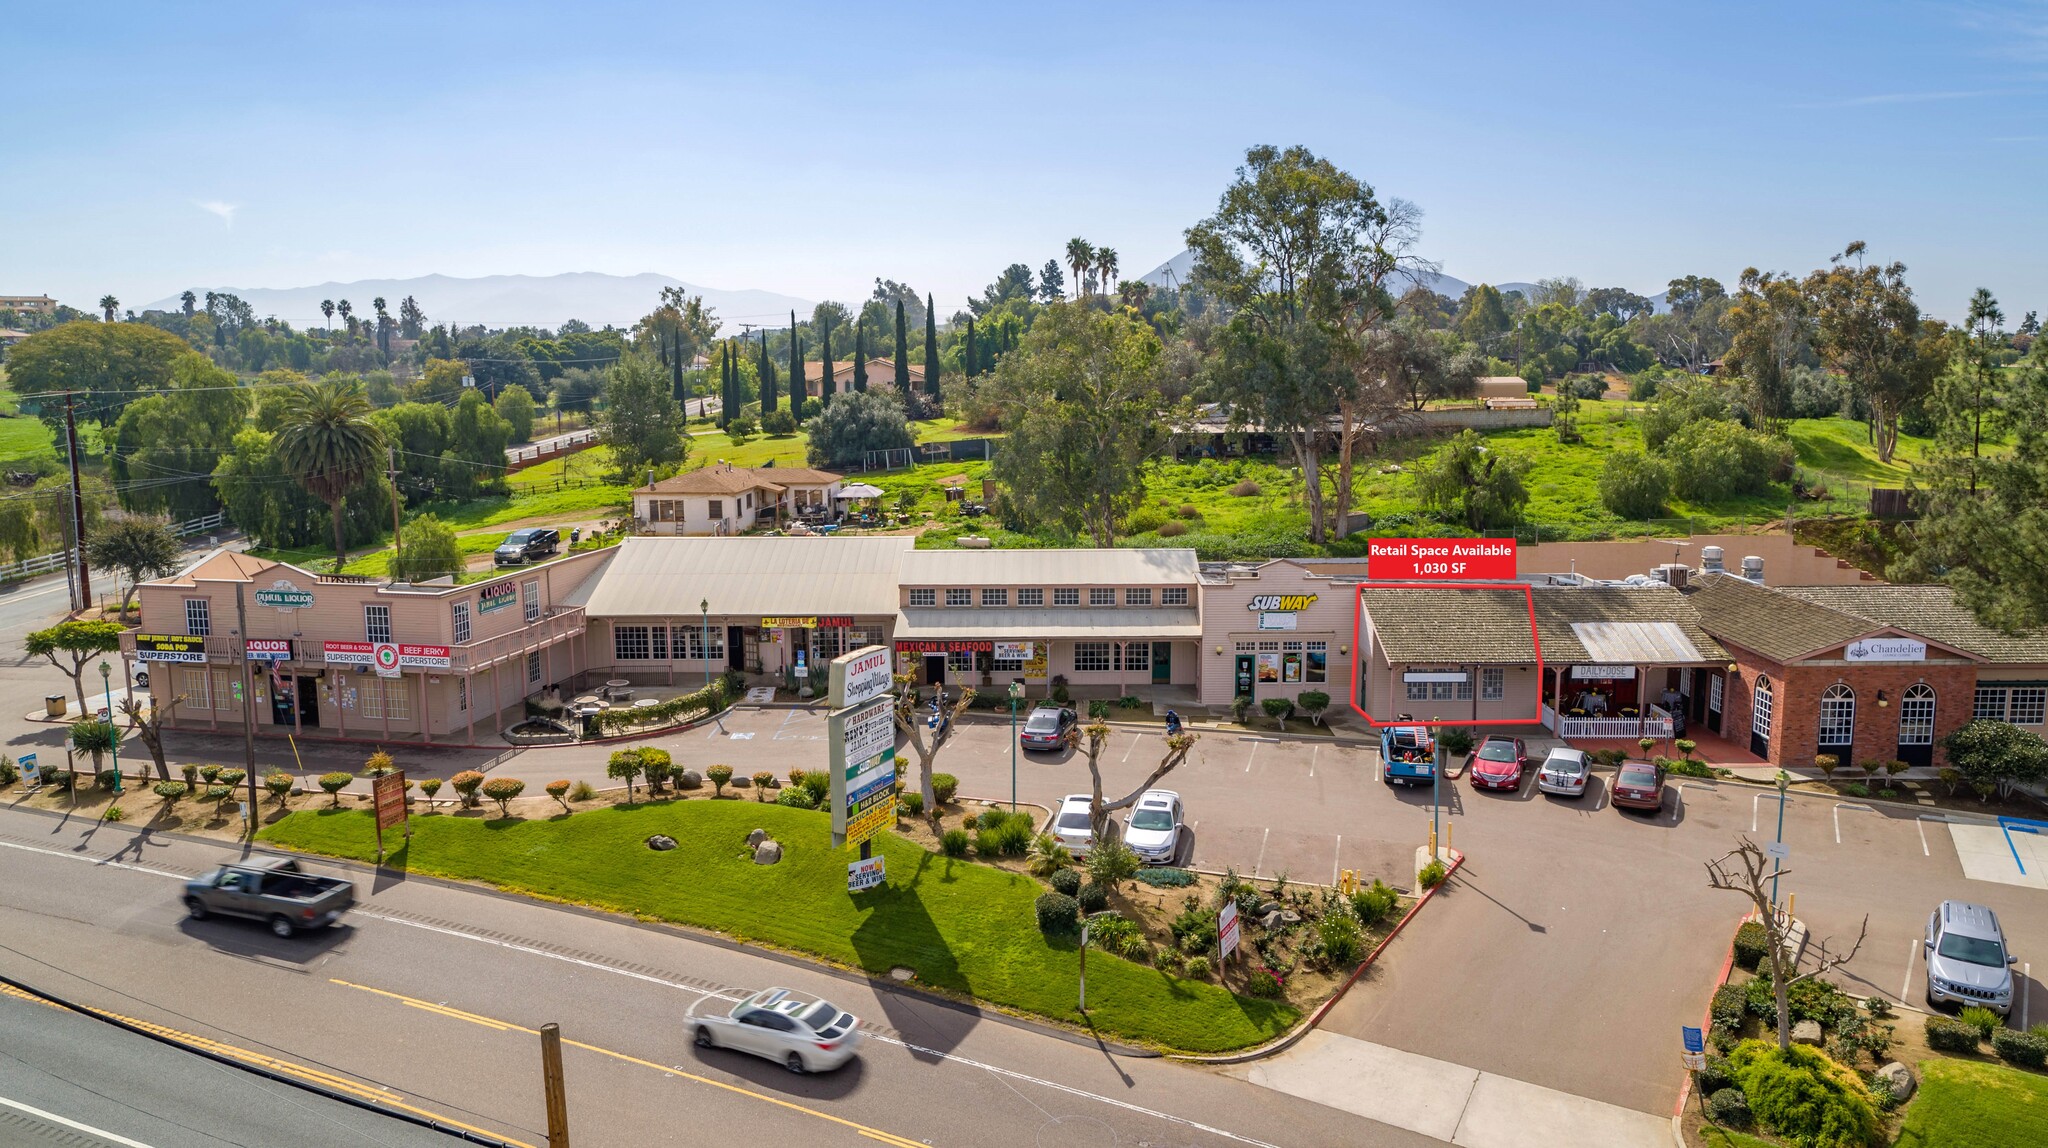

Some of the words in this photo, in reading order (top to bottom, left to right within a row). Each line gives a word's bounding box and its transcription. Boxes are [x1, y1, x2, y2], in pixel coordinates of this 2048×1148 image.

[485, 582, 516, 599] LIQUOR
[284, 594, 313, 603] LIQUOR
[1247, 593, 1318, 611] SUBWAY
[818, 617, 854, 628] JAMUL
[404, 646, 422, 655] BEEF
[423, 648, 445, 656] JERKY
[896, 641, 937, 652] MEXICAN
[939, 642, 946, 652] &
[948, 642, 993, 652] SEAFOOD
[1871, 643, 1925, 654] Chandelier
[140, 651, 203, 661] SUPERSTORE
[326, 653, 373, 663] SUPERSTORE!
[401, 656, 449, 666] SUPERSTORE!
[850, 654, 886, 676] JAMUL
[1581, 666, 1602, 676] DAILY
[1606, 666, 1626, 675] DOSE
[847, 679, 874, 697] Shopping
[872, 671, 890, 689] Village
[852, 703, 885, 725] HARDWARE
[844, 722, 869, 743] RENO'S
[860, 798, 872, 810] H&R
[872, 788, 889, 803] BLOCK
[847, 810, 873, 825] MEXICAN
[874, 799, 889, 811] FOOD
[860, 864, 874, 873] NOW
[848, 880, 864, 889] BEER
[871, 873, 886, 883] WINE
[855, 871, 880, 881] SERVING
